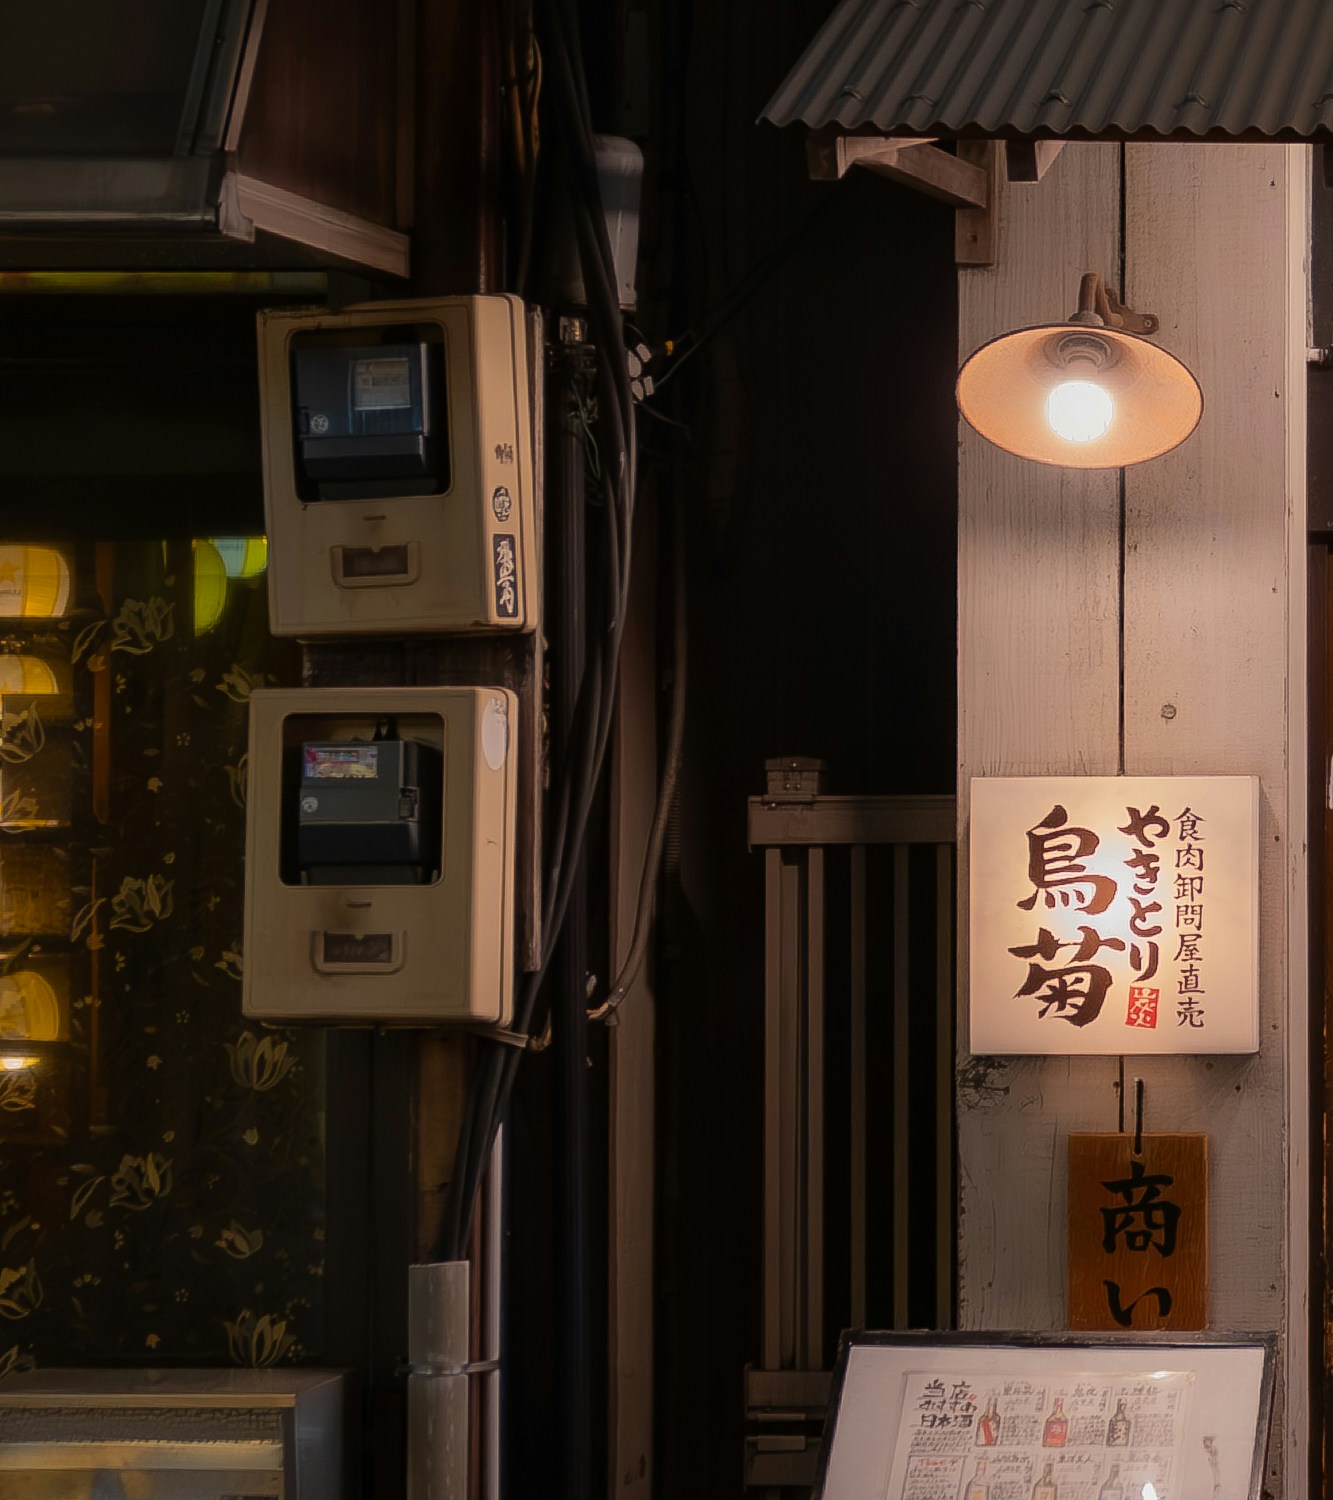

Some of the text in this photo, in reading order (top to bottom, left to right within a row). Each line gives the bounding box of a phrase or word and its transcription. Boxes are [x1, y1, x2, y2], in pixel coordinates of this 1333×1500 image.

[1007, 803, 1119, 1028] 鳥菊
[1118, 804, 1171, 984] やきとり
[1173, 806, 1207, 1029] 食肉卸問屋直売
[1099, 1160, 1183, 1329] 商い
